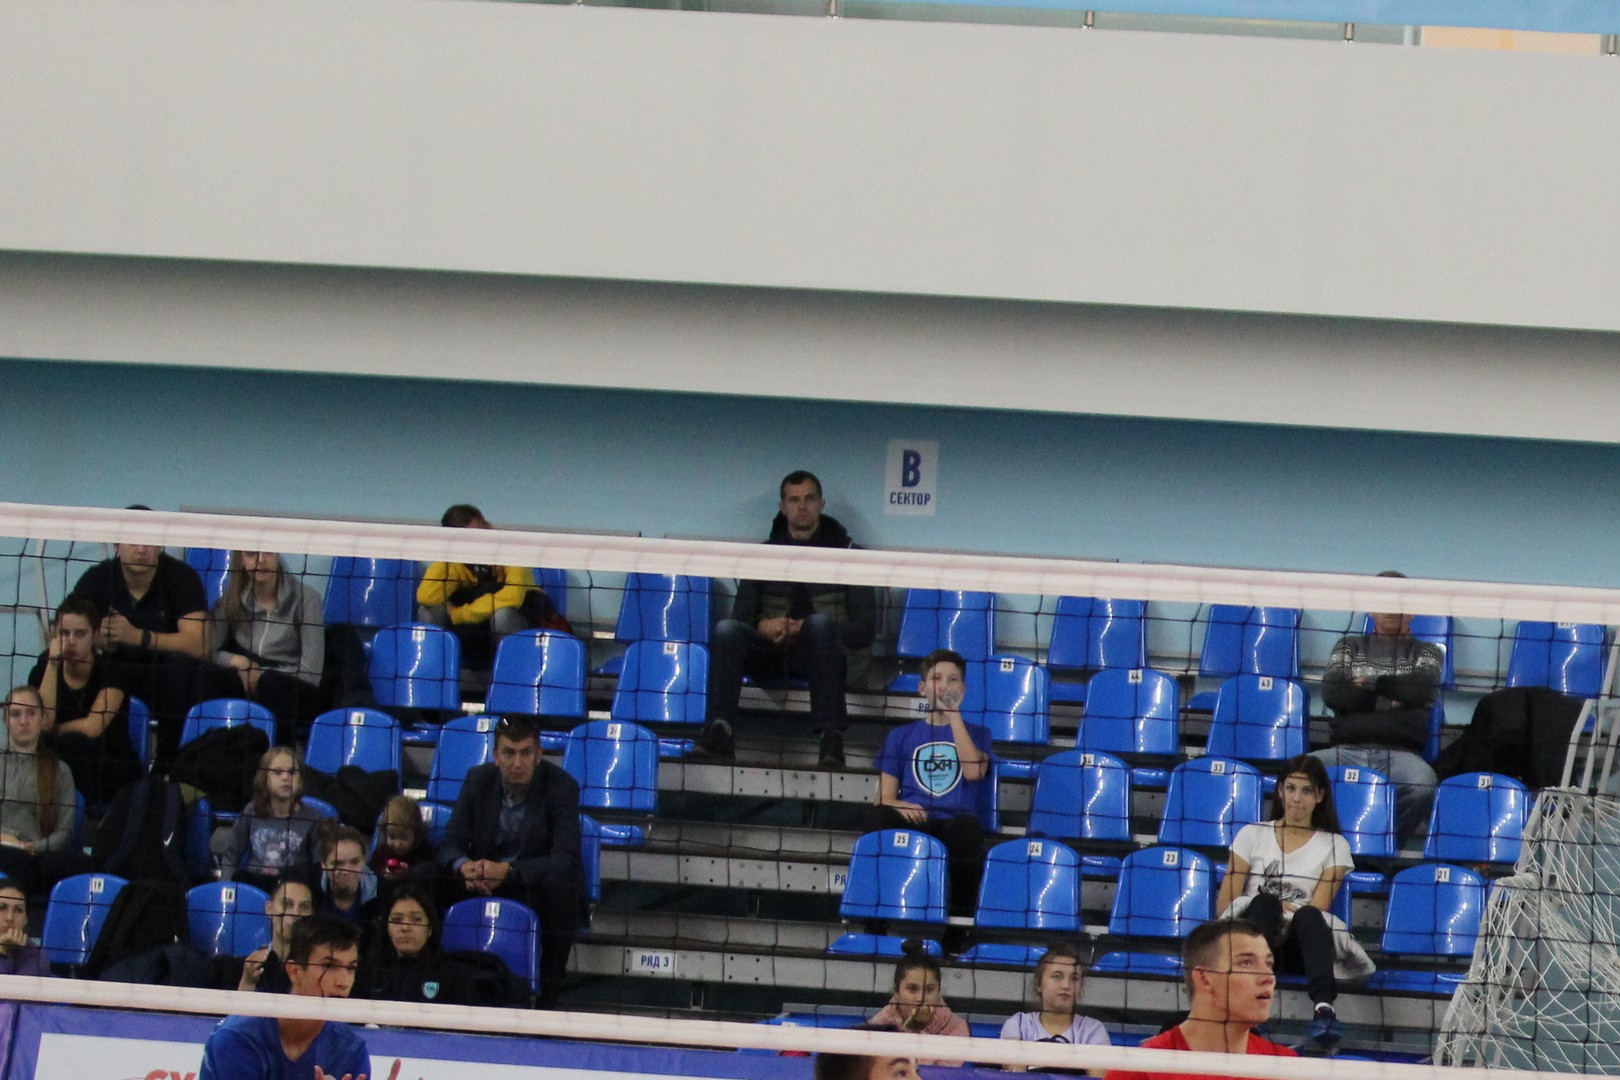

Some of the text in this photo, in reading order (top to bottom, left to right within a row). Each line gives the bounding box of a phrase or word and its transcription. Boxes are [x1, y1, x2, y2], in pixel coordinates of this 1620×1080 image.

[902, 449, 921, 487] В
[890, 491, 931, 505] СЕКТОР
[1214, 764, 1222, 772] 33
[1347, 772, 1356, 780] 32
[1481, 778, 1490, 786] 31
[897, 836, 906, 844] 25
[1031, 844, 1039, 852] 24
[1166, 854, 1175, 862] 23
[834, 868, 847, 884] РЯ
[1438, 870, 1446, 878] 21
[640, 955, 669, 968] РЯД 3
